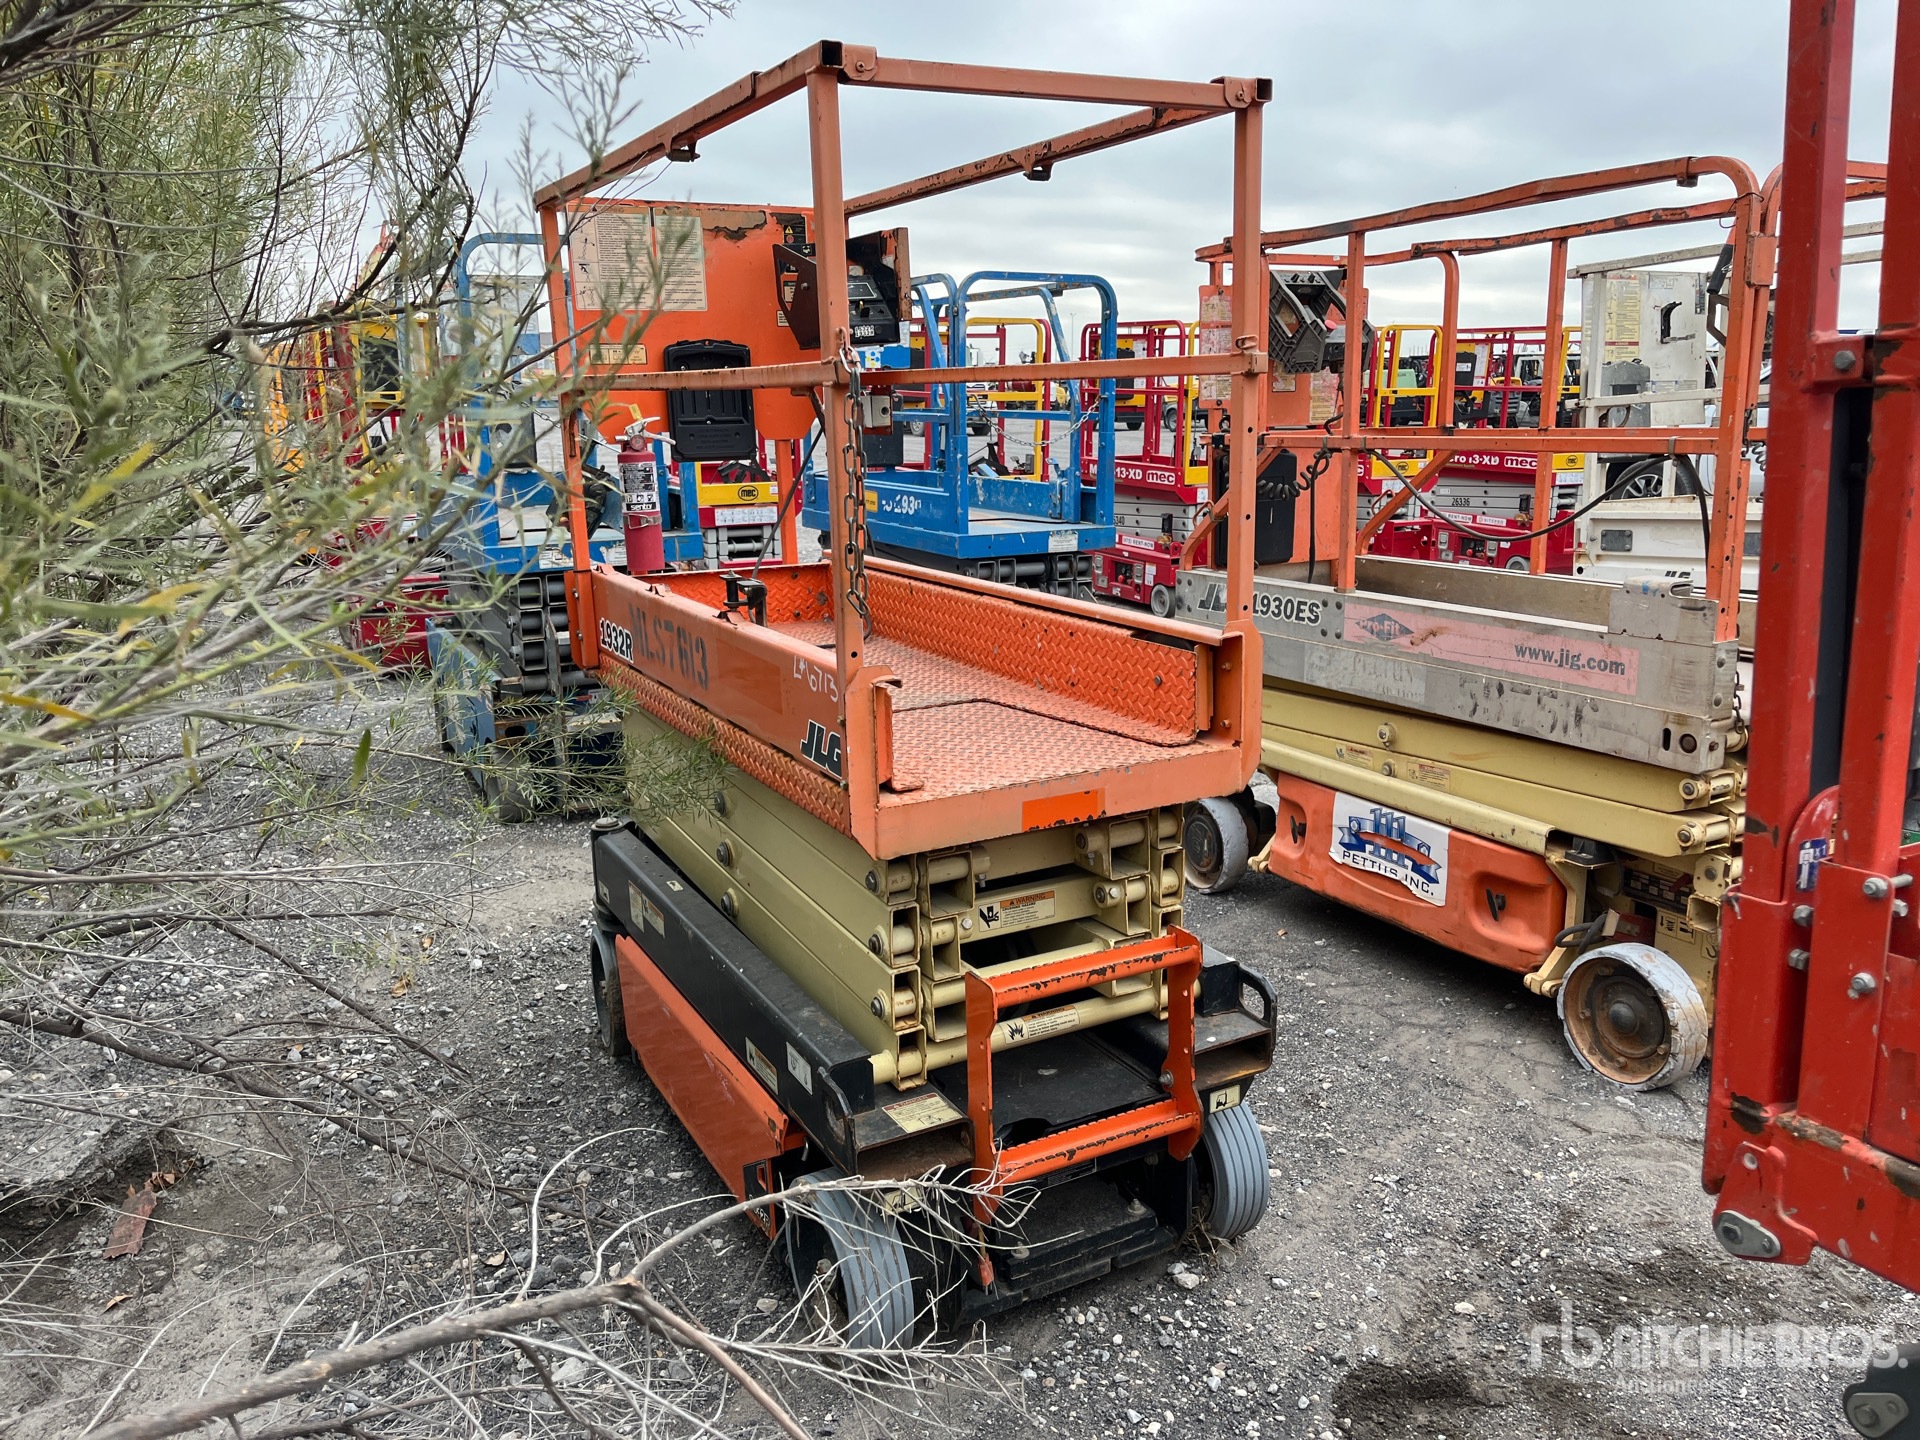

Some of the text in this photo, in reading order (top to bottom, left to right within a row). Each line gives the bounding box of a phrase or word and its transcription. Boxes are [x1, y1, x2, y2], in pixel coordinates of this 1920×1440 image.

[1147, 471, 1175, 485] mec
[599, 617, 634, 664] 1932R
[800, 719, 842, 779] JLG
[1014, 892, 1046, 906] WARNING
